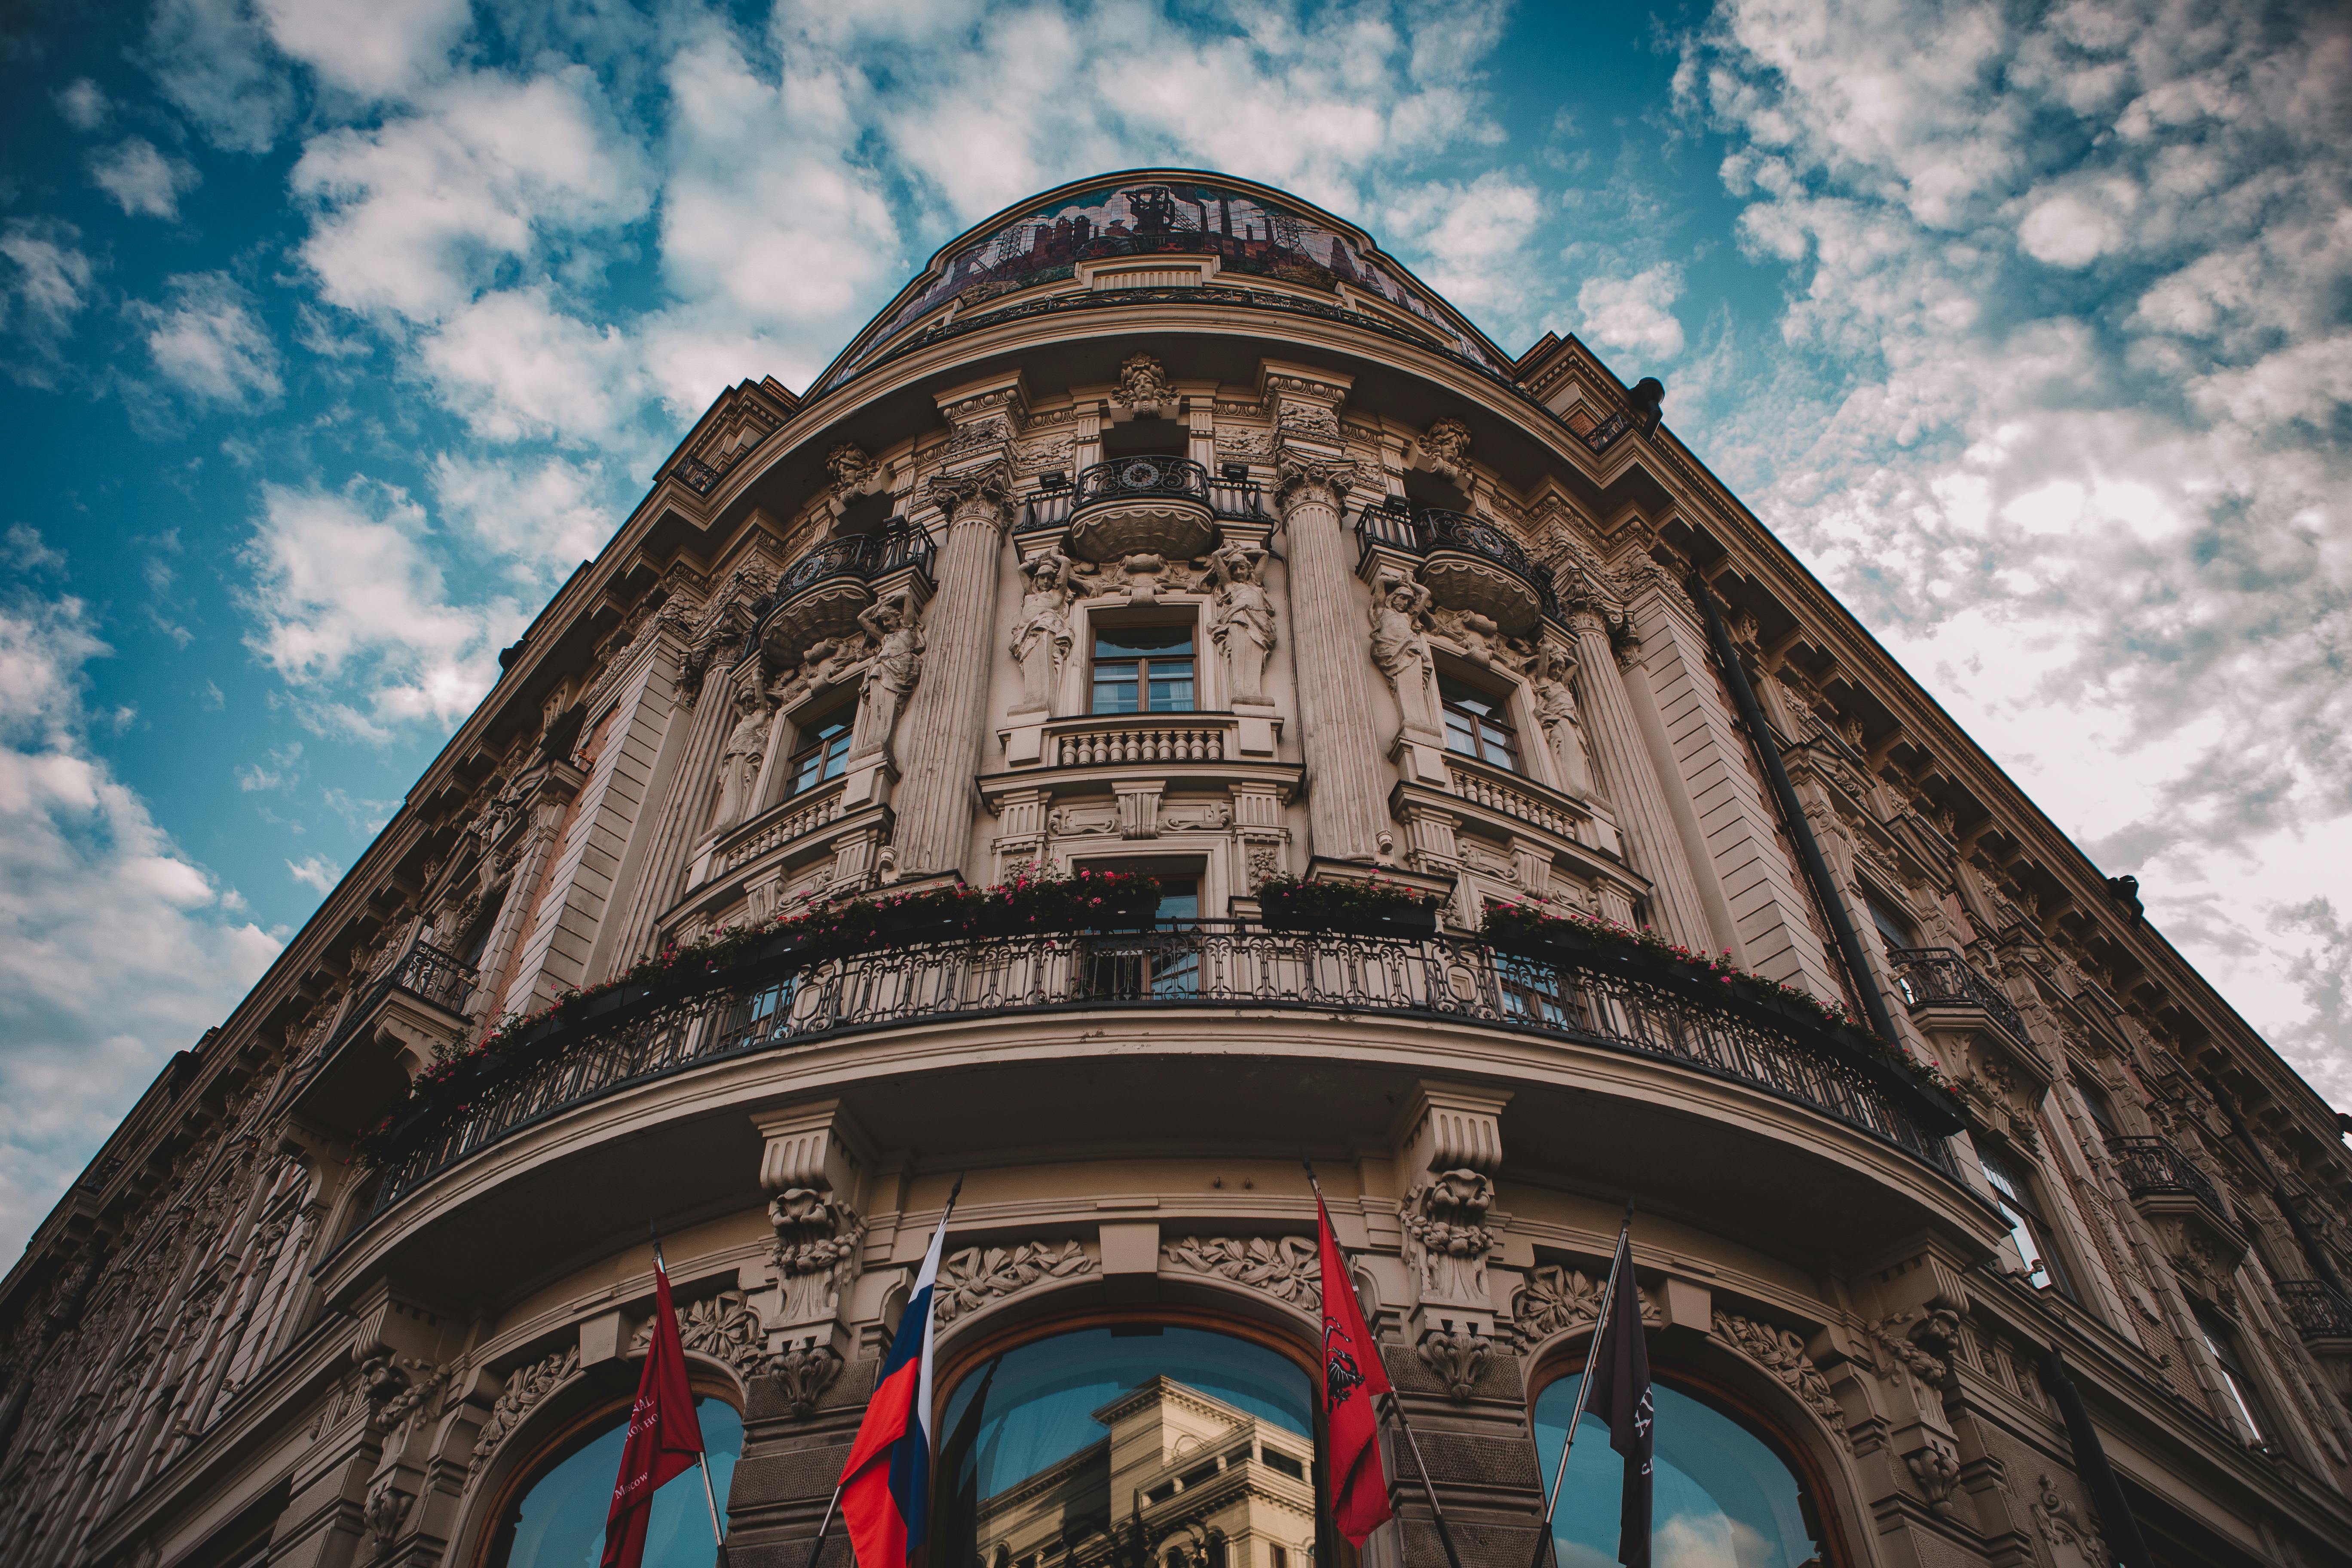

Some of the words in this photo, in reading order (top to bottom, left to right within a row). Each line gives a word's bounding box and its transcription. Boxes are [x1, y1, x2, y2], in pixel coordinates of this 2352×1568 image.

[626, 1423, 643, 1442] ION
[643, 1413, 658, 1429] HO
[615, 1472, 648, 1499] Moscow
